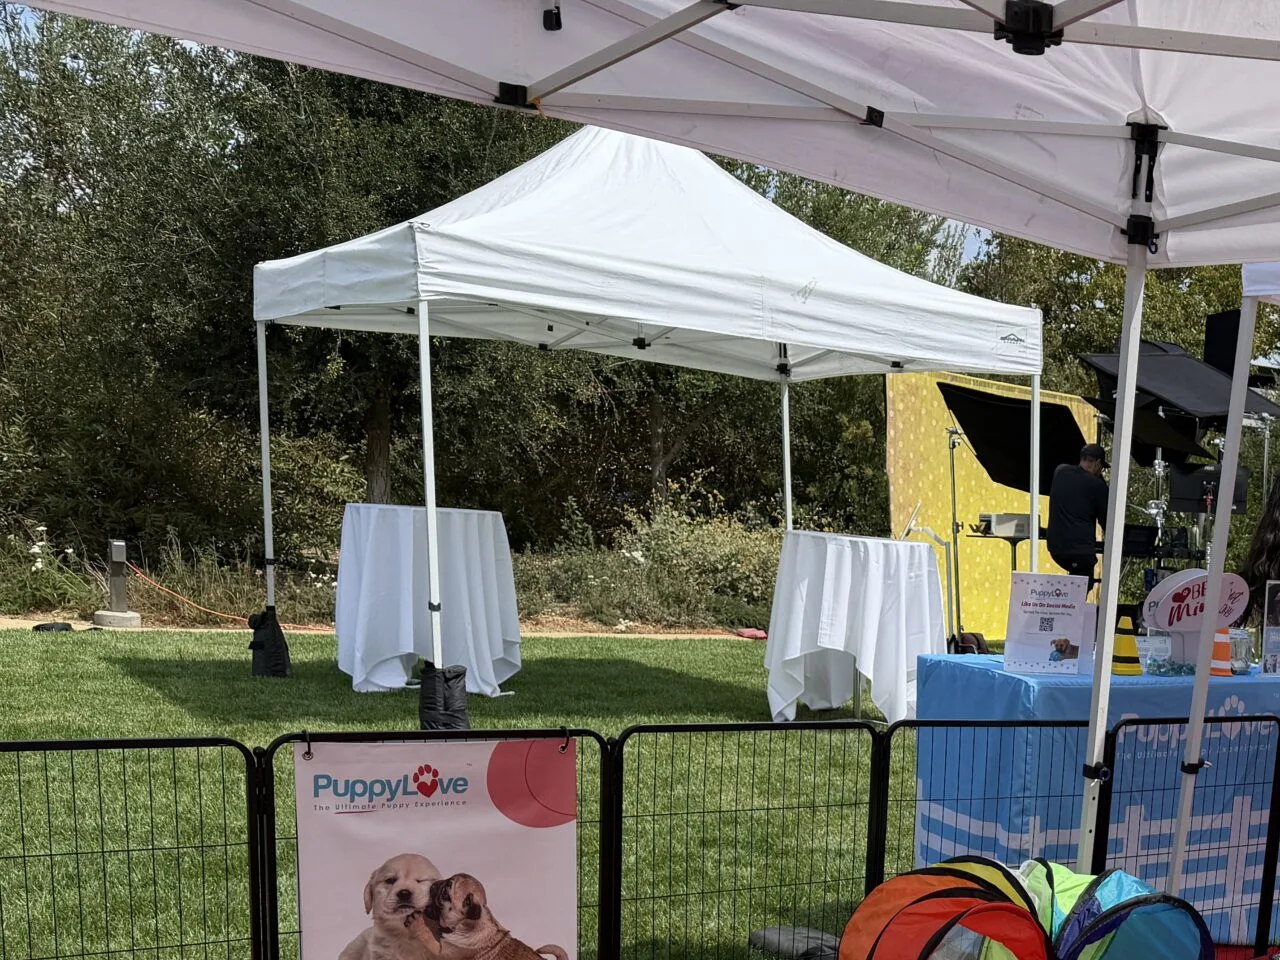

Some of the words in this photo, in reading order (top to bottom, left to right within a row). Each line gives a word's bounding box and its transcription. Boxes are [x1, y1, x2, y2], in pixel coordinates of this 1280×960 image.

[1031, 588, 1068, 598] PuppyLove
[1118, 695, 1275, 750] PuppLove
[313, 764, 469, 803] PuppyLove
[414, 800, 467, 808] Experience
